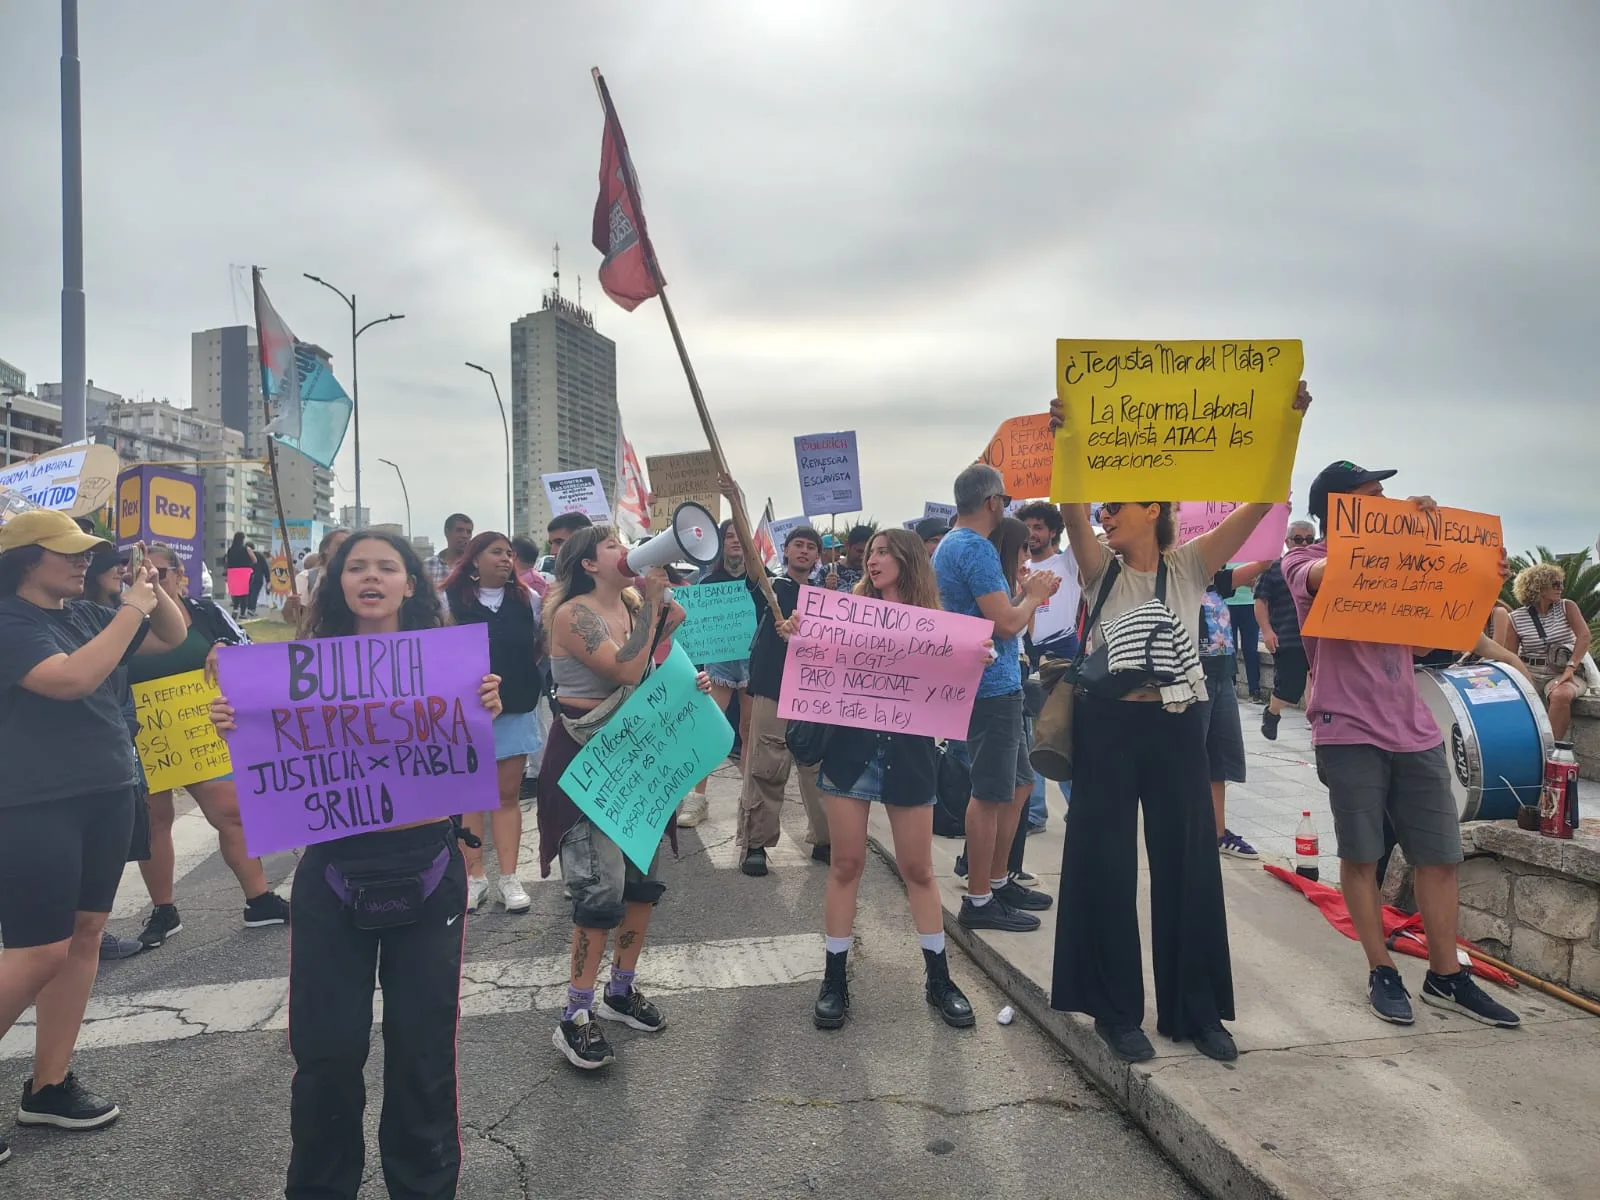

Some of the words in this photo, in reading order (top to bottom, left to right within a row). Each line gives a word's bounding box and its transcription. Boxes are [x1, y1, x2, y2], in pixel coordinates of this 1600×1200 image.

[1155, 344, 1191, 374] Mar
[1195, 347, 1216, 372] del
[1222, 344, 1281, 373] Plata?
[1091, 396, 1114, 425] La
[1121, 394, 1188, 428] Reforma
[1192, 388, 1254, 421] Laboral
[1088, 422, 1157, 448] esclavista
[1163, 426, 1217, 447] ATACA
[1229, 422, 1254, 448] las
[31, 458, 75, 478] LABORAL
[801, 456, 848, 470] REPRESORA
[804, 472, 850, 487] ESCLAVISTA
[122, 498, 139, 519] Rex
[156, 496, 190, 520] Rex
[1336, 498, 1362, 534] NI
[1365, 512, 1425, 538] COLONIA
[1425, 510, 1442, 542] NI
[1444, 521, 1500, 548] ESCLAVOS
[180, 544, 194, 552] todo
[1350, 547, 1390, 570] Fuera
[1448, 554, 1470, 574] de
[705, 585, 733, 598] BANCO
[1352, 572, 1398, 591] América
[1401, 576, 1445, 592] Latina
[804, 591, 834, 621] EL
[836, 597, 911, 632] SILENCIO
[916, 617, 935, 632] es
[1392, 604, 1434, 620] LABORAL
[1440, 600, 1474, 622] NO!
[796, 644, 829, 662] está
[835, 648, 847, 664] la
[288, 638, 425, 702] BULLRICH
[800, 667, 835, 690] PARO
[843, 672, 914, 695] NACIONAL
[154, 682, 205, 703] REFORMA
[146, 708, 172, 731] NO
[272, 696, 472, 752] REPRESORA
[658, 711, 672, 728] de
[792, 698, 809, 714] no
[813, 700, 832, 714] se
[836, 698, 868, 720] trate
[874, 703, 887, 726] la
[893, 706, 912, 730] ley
[570, 760, 600, 792] LA
[646, 682, 668, 709] MUY
[157, 752, 182, 771] NO
[248, 749, 365, 794] JUSTICIA
[396, 744, 478, 778] PABLO
[605, 770, 644, 826] BULLRICH
[642, 754, 655, 770] es
[651, 740, 667, 756] la
[666, 700, 699, 744] griega
[622, 794, 648, 839] BASADA
[648, 777, 660, 794] en
[657, 763, 674, 780] la
